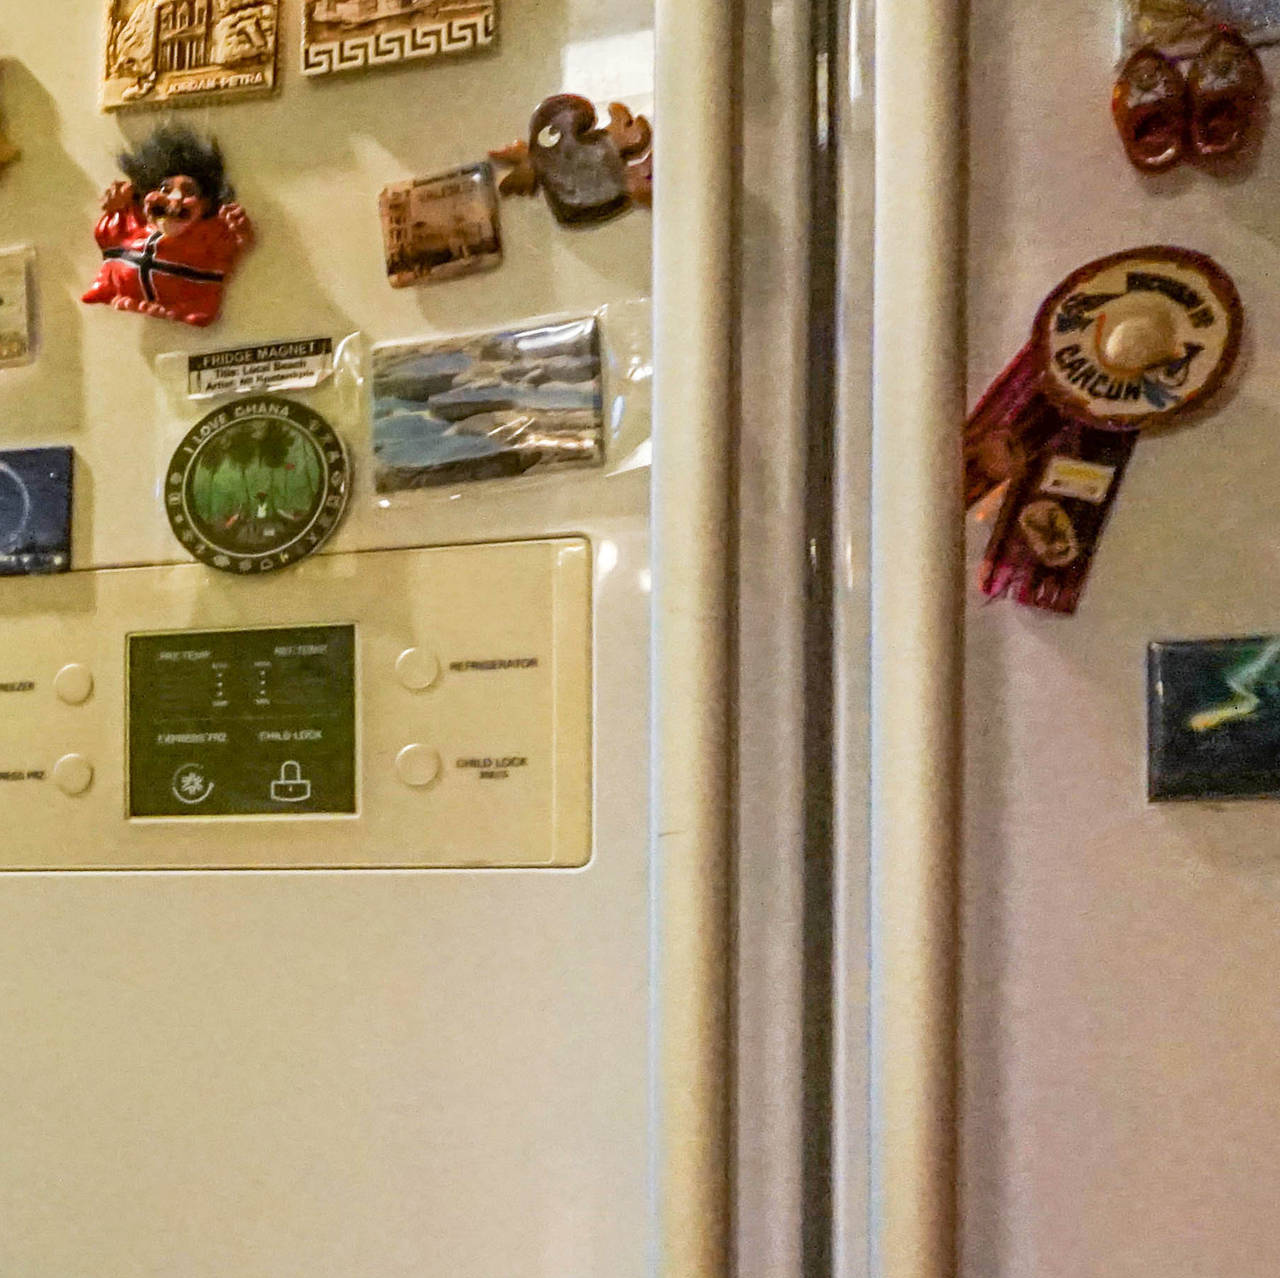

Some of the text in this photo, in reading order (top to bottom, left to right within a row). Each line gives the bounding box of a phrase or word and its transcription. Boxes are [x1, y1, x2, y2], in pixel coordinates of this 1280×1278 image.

[202, 342, 315, 367] FRIDGE MAGNET
[1055, 343, 1141, 400] CANCUN
[192, 412, 227, 445] LOVE
[235, 403, 290, 418] GHANA
[455, 757, 528, 769] CHILD LOCK
